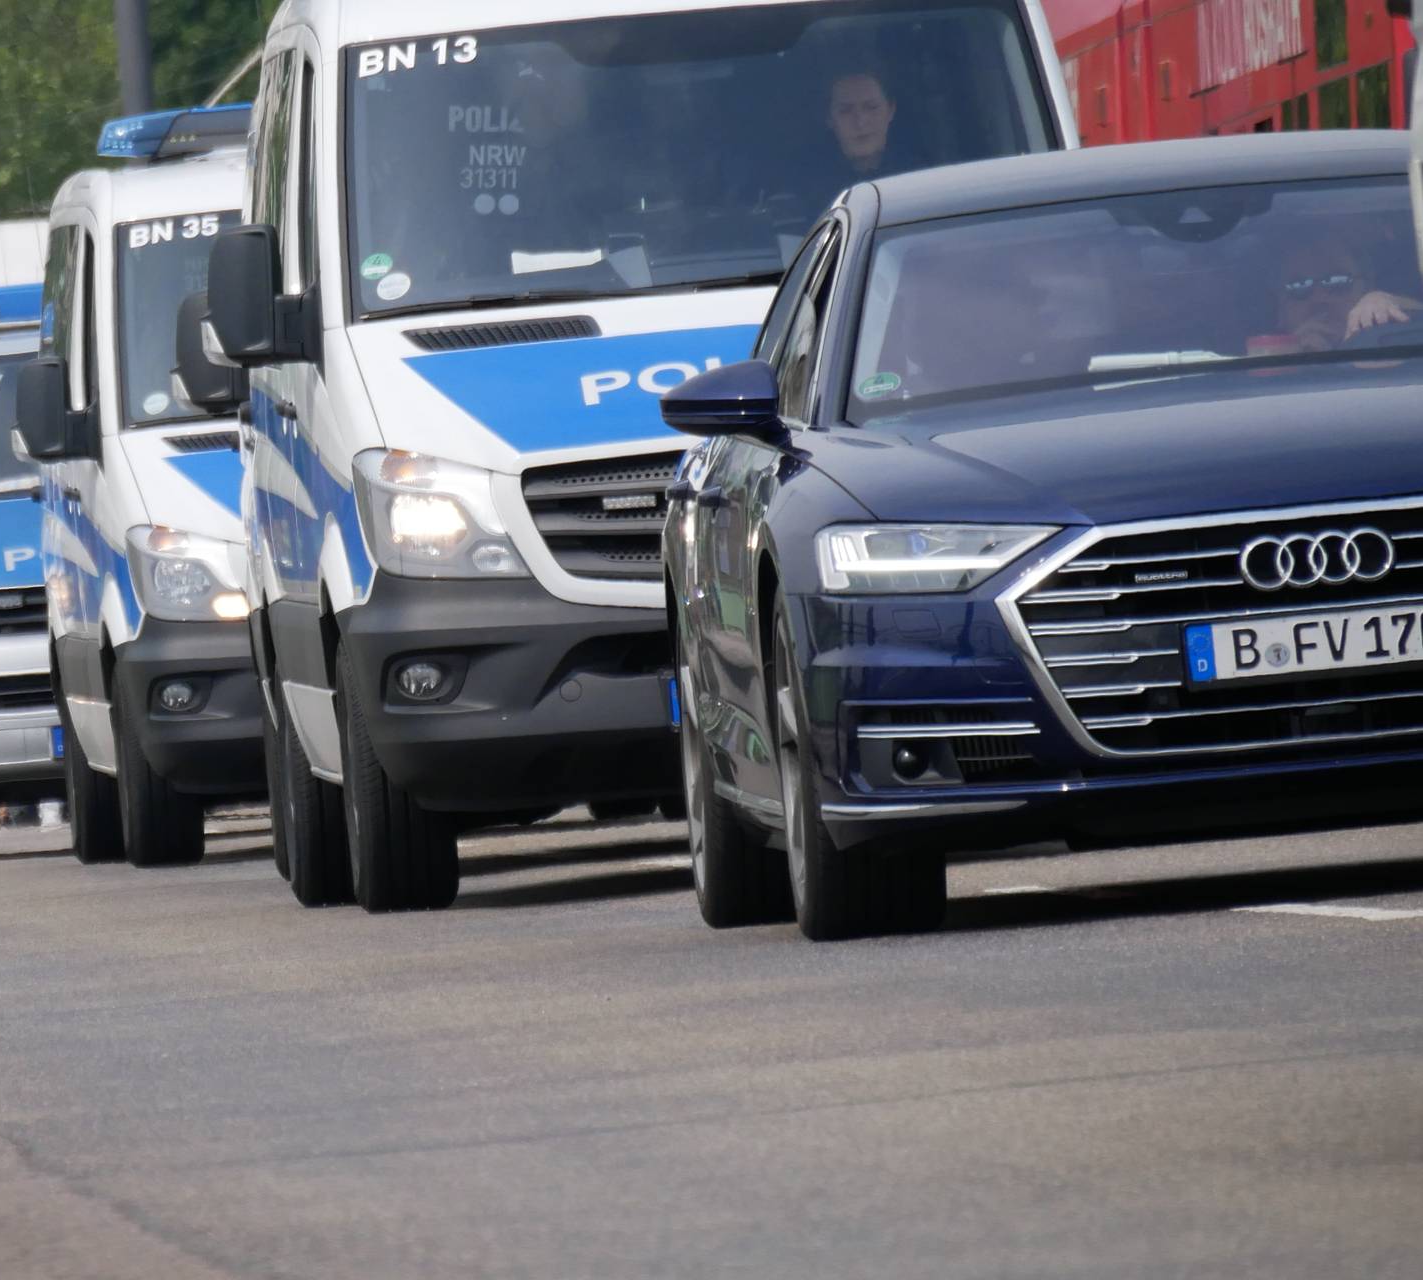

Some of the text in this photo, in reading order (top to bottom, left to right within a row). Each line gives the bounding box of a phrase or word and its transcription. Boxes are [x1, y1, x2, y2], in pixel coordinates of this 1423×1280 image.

[359, 35, 478, 78] BN 13
[468, 144, 526, 167] NRW
[460, 167, 517, 189] 31311
[129, 214, 219, 249] BN 35
[580, 357, 722, 406] PO
[3, 548, 43, 572] P
[1197, 613, 1423, 672] D B FV 17
